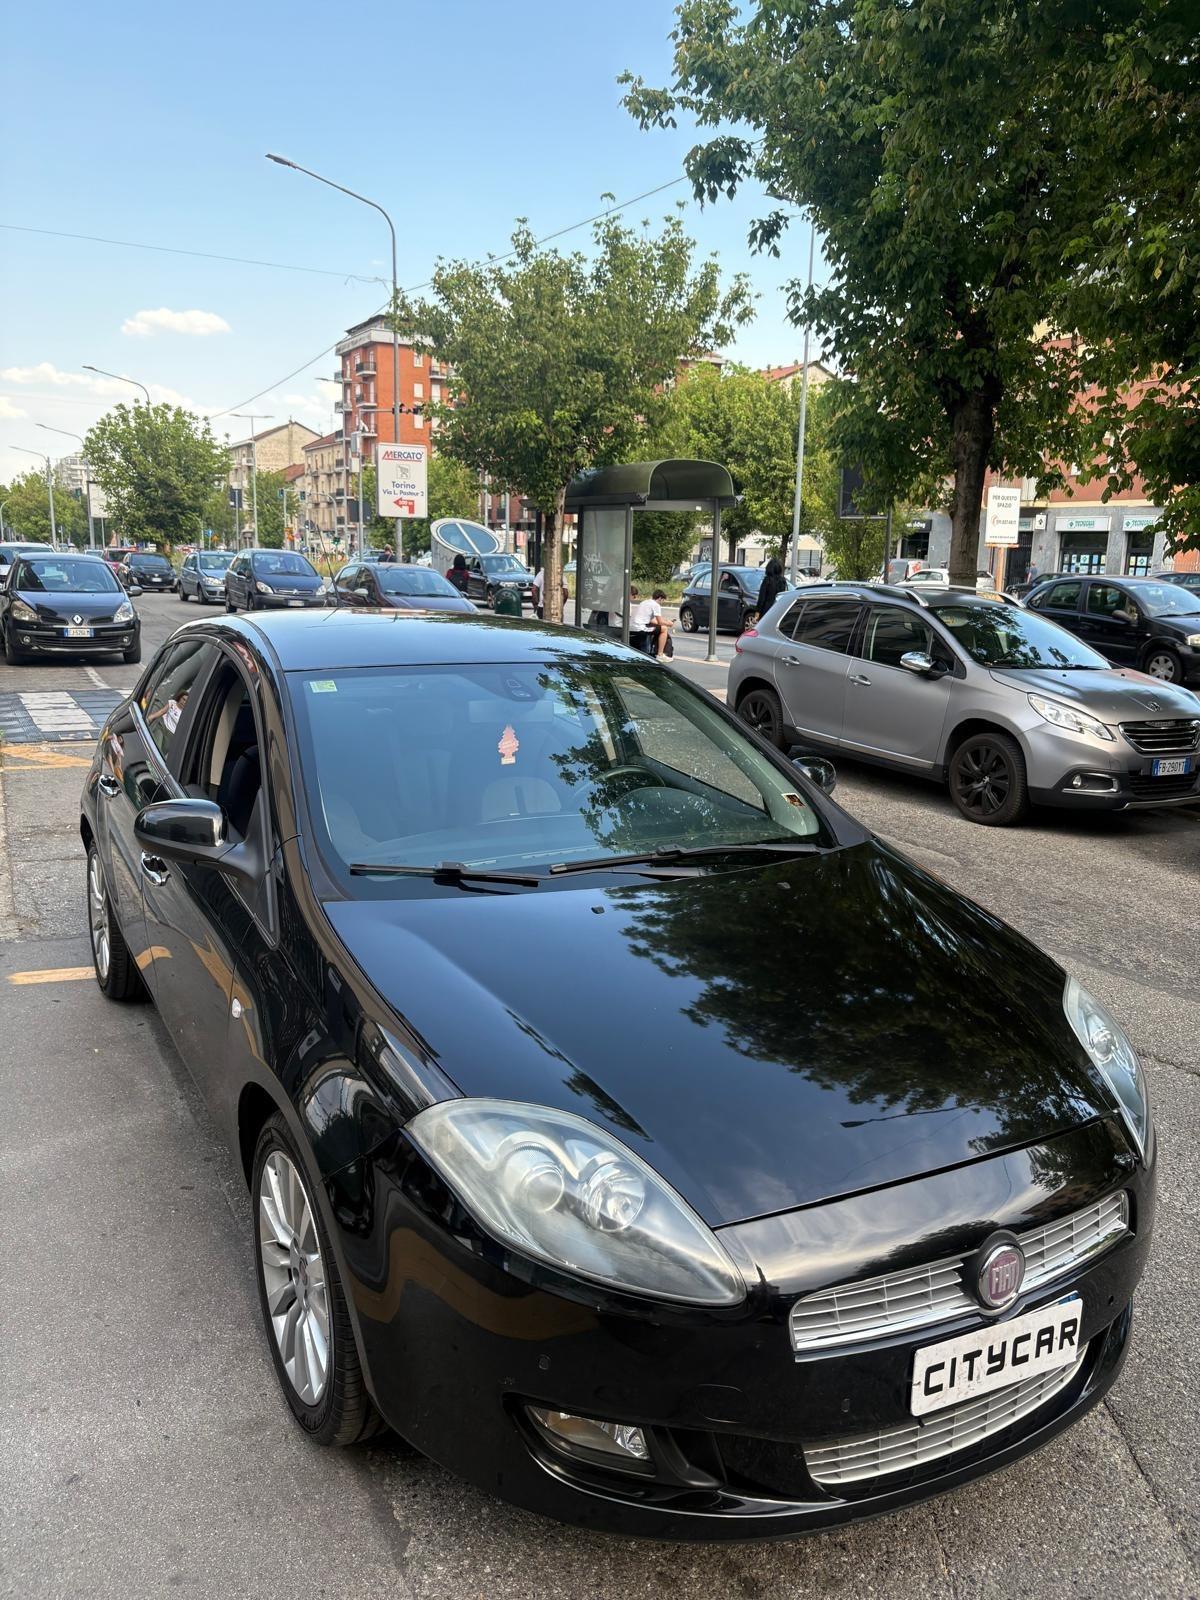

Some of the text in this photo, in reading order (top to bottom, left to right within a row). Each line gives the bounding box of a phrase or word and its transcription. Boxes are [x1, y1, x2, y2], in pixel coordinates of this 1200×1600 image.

[392, 481, 416, 489] Torino
[991, 1261, 1017, 1294] FIAT
[923, 1317, 1078, 1397] CITYCAR
